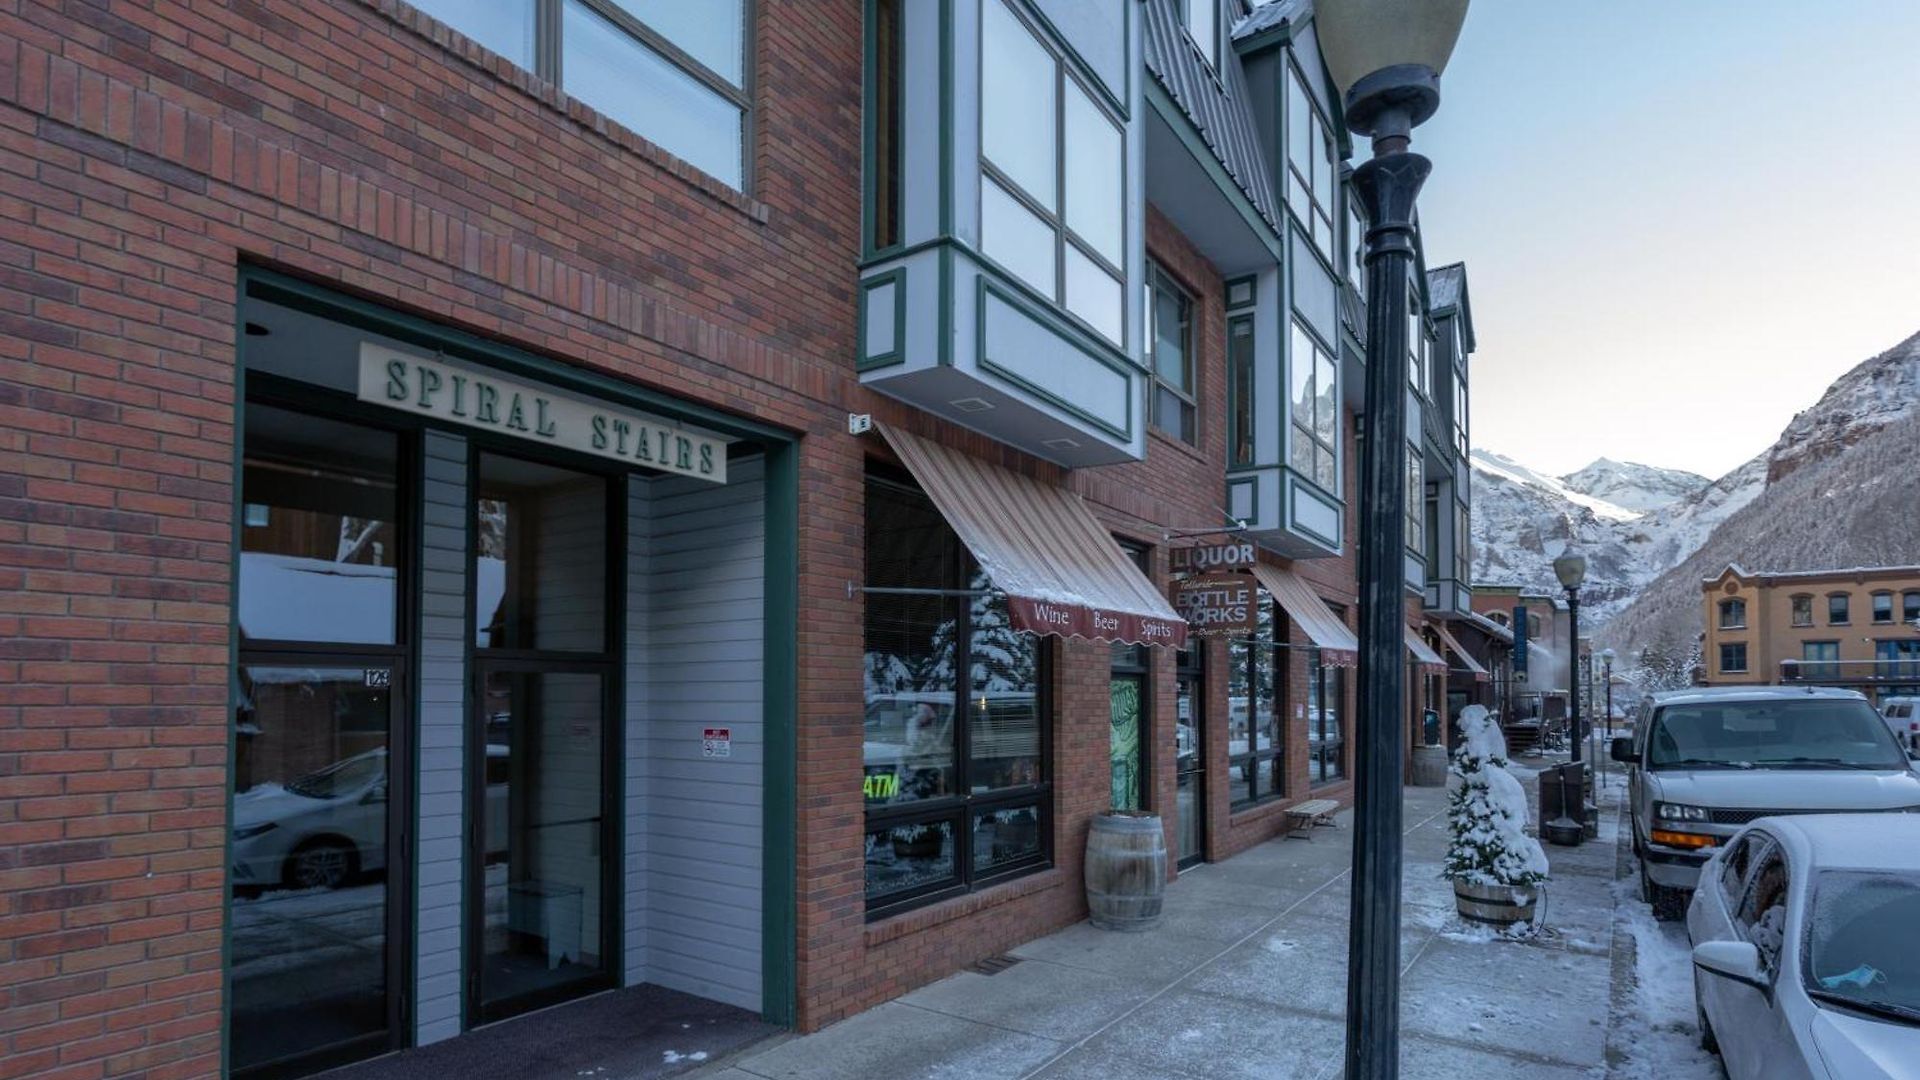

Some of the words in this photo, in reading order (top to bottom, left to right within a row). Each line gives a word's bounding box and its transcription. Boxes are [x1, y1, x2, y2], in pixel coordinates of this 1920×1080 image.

[386, 359, 556, 437] SPIRAL
[591, 414, 713, 474] STAIRS
[1174, 544, 1255, 569] LIQUOR
[1176, 590, 1249, 607] BOTTLE
[1034, 603, 1069, 625] Wine
[1094, 611, 1120, 631] Beer
[1141, 619, 1172, 641] Spirits
[1178, 607, 1247, 625] WORKS
[863, 774, 899, 798] ATM
